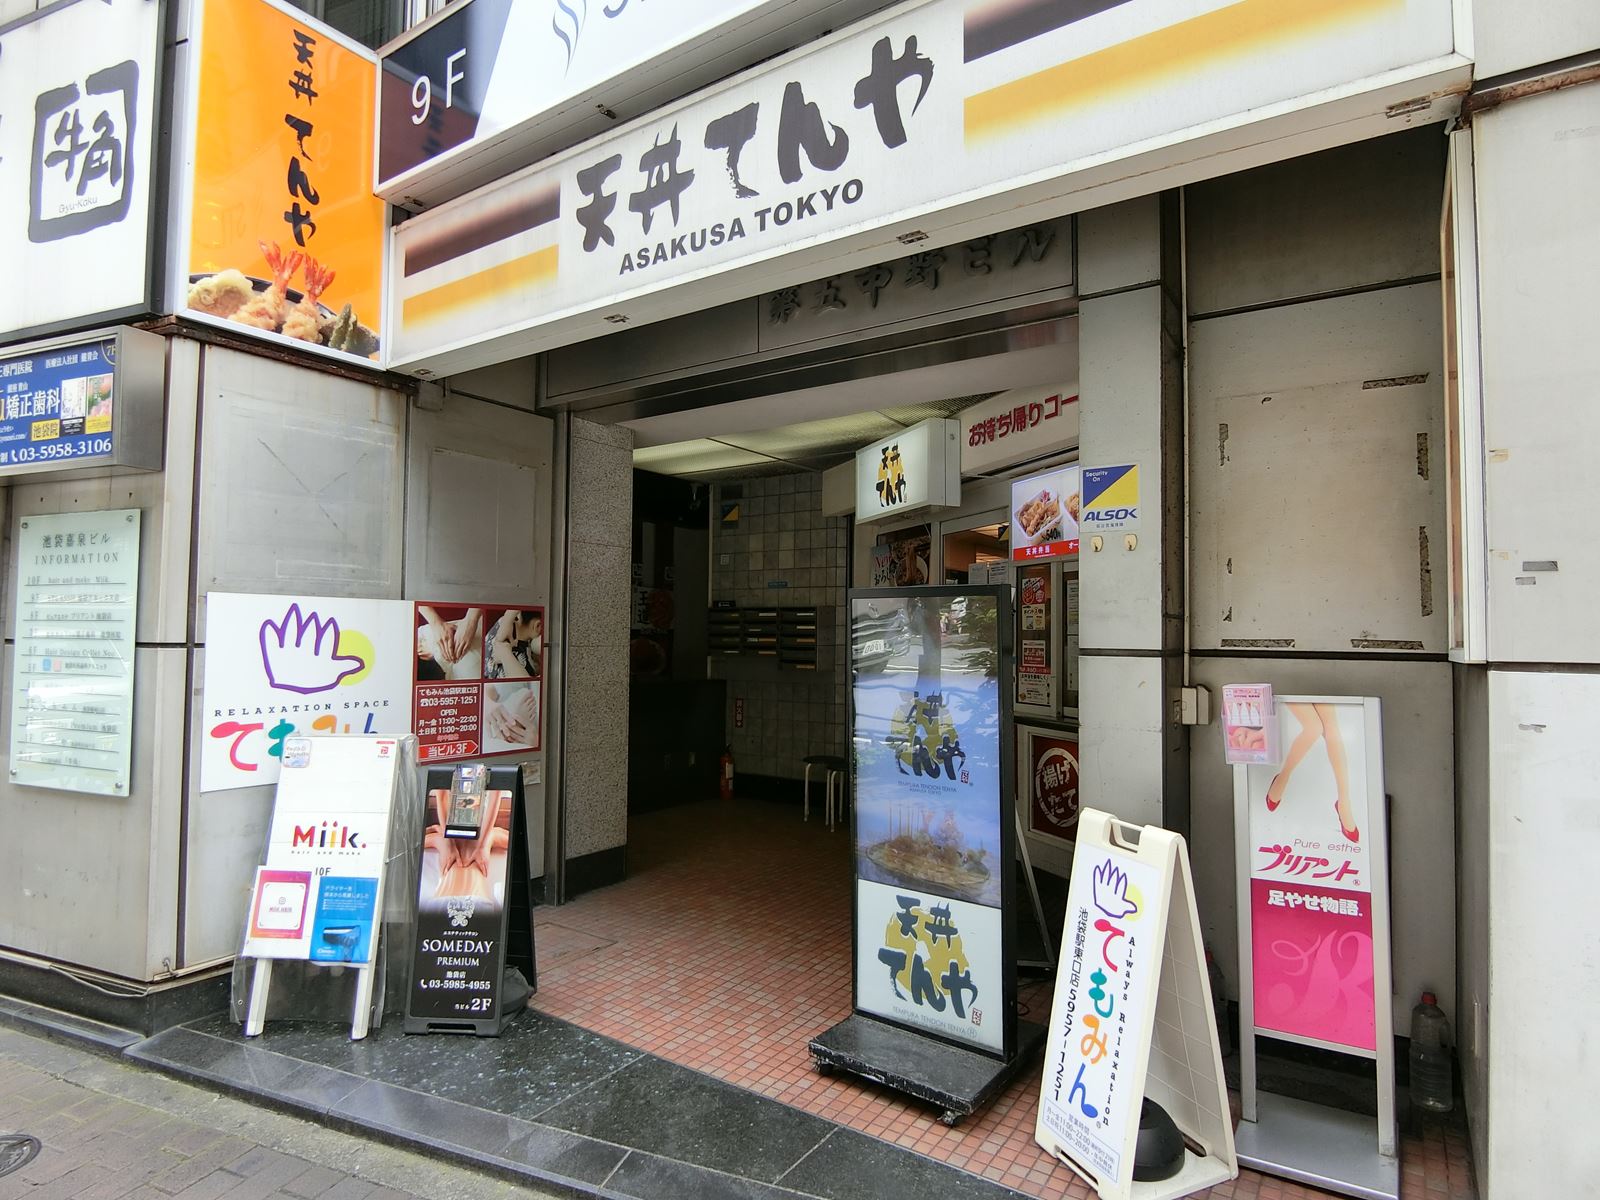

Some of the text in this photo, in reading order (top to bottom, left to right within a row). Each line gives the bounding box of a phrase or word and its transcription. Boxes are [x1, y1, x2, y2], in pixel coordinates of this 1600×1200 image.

[44, 108, 123, 196] 牛角
[618, 178, 864, 275] ASAKUSA TOKYO
[20, 438, 112, 461] 03-5958-3106
[1086, 470, 1109, 478] Security
[1084, 508, 1138, 522] ALSOK
[35, 552, 120, 566] INFORMATION
[214, 700, 391, 718] RELAXATION SPACE
[429, 696, 476, 707] 03-5957-1251
[418, 727, 437, 736] 土日祝
[1041, 758, 1070, 790] 揚げ
[1047, 789, 1078, 816] たて
[1294, 838, 1361, 854] Pure esthe
[1257, 844, 1360, 882] ブリアント
[422, 939, 494, 954] SOMEDAY
[437, 956, 480, 967] PREMIUM
[429, 979, 491, 990] 03-5985-4955
[878, 947, 979, 1019] てんや
[471, 997, 492, 1011] 2F
[1068, 918, 1126, 1119] てもみん
